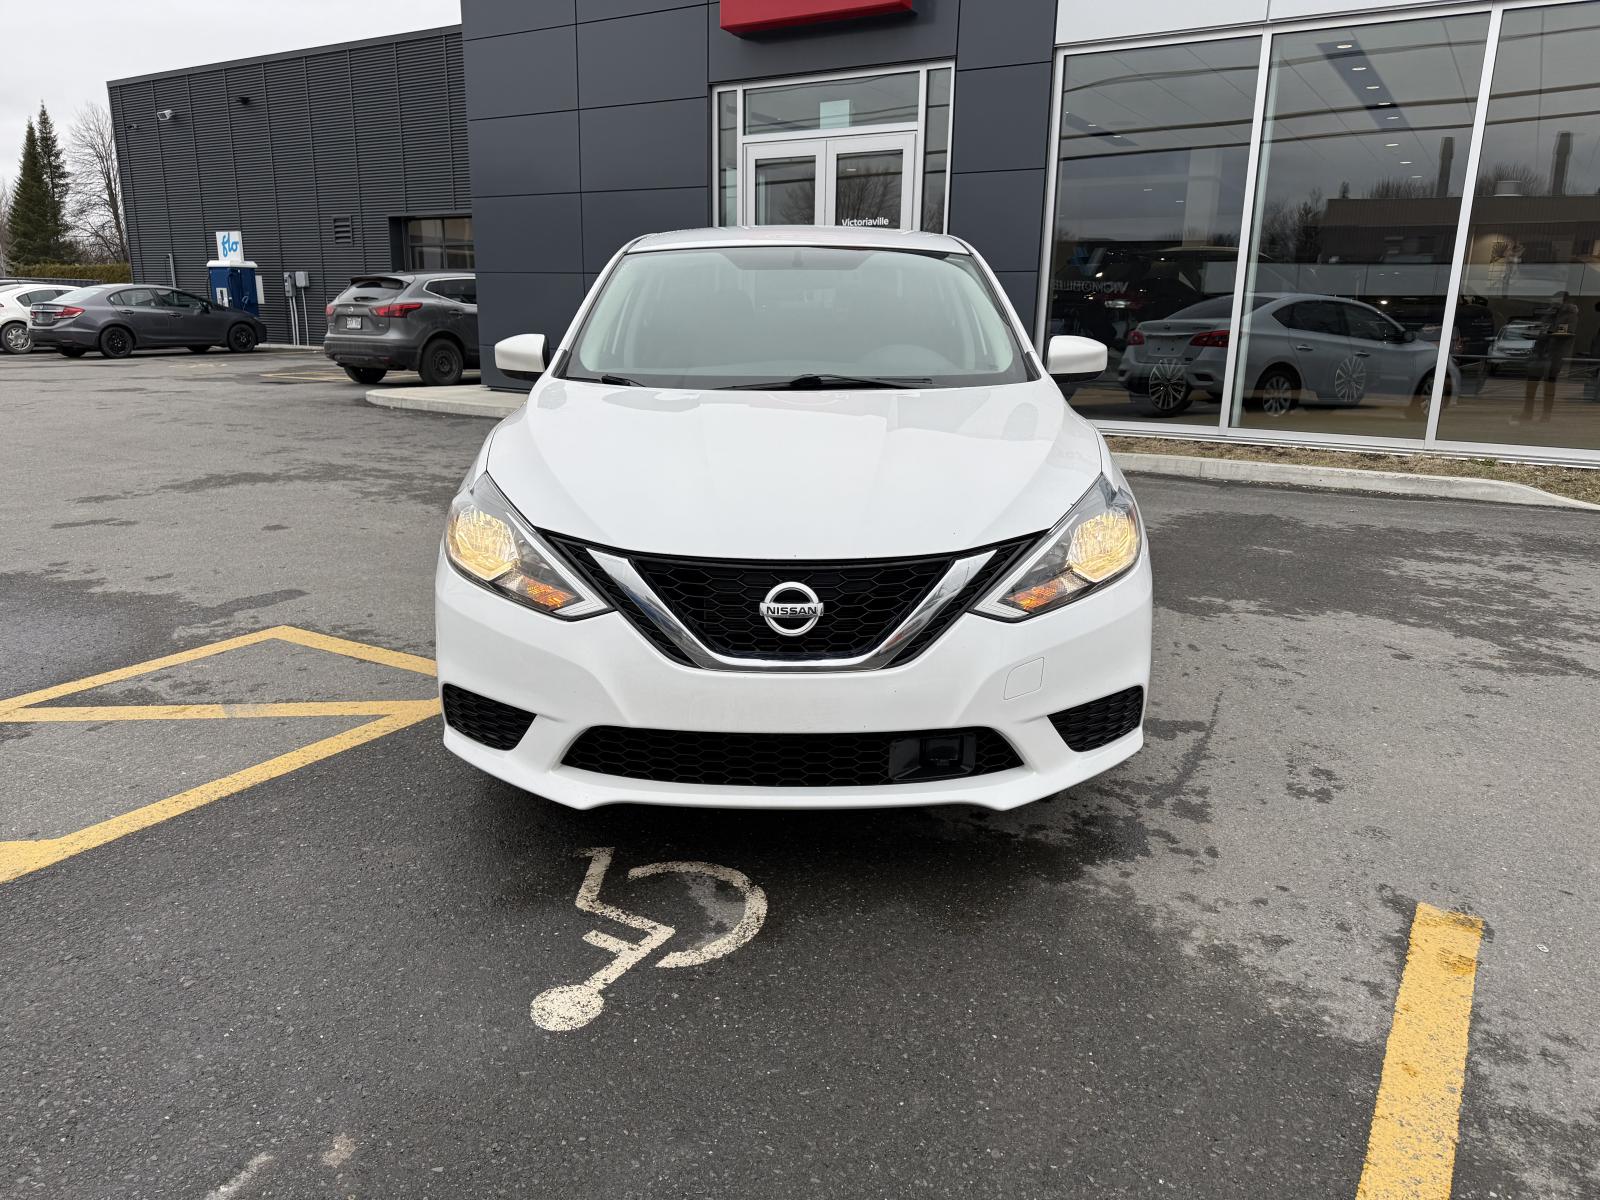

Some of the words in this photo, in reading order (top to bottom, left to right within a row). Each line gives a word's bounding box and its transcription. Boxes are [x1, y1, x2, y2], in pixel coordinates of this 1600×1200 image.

[841, 216, 890, 227] Victoriaville
[221, 231, 240, 258] flo
[766, 606, 817, 615] NISSAN
